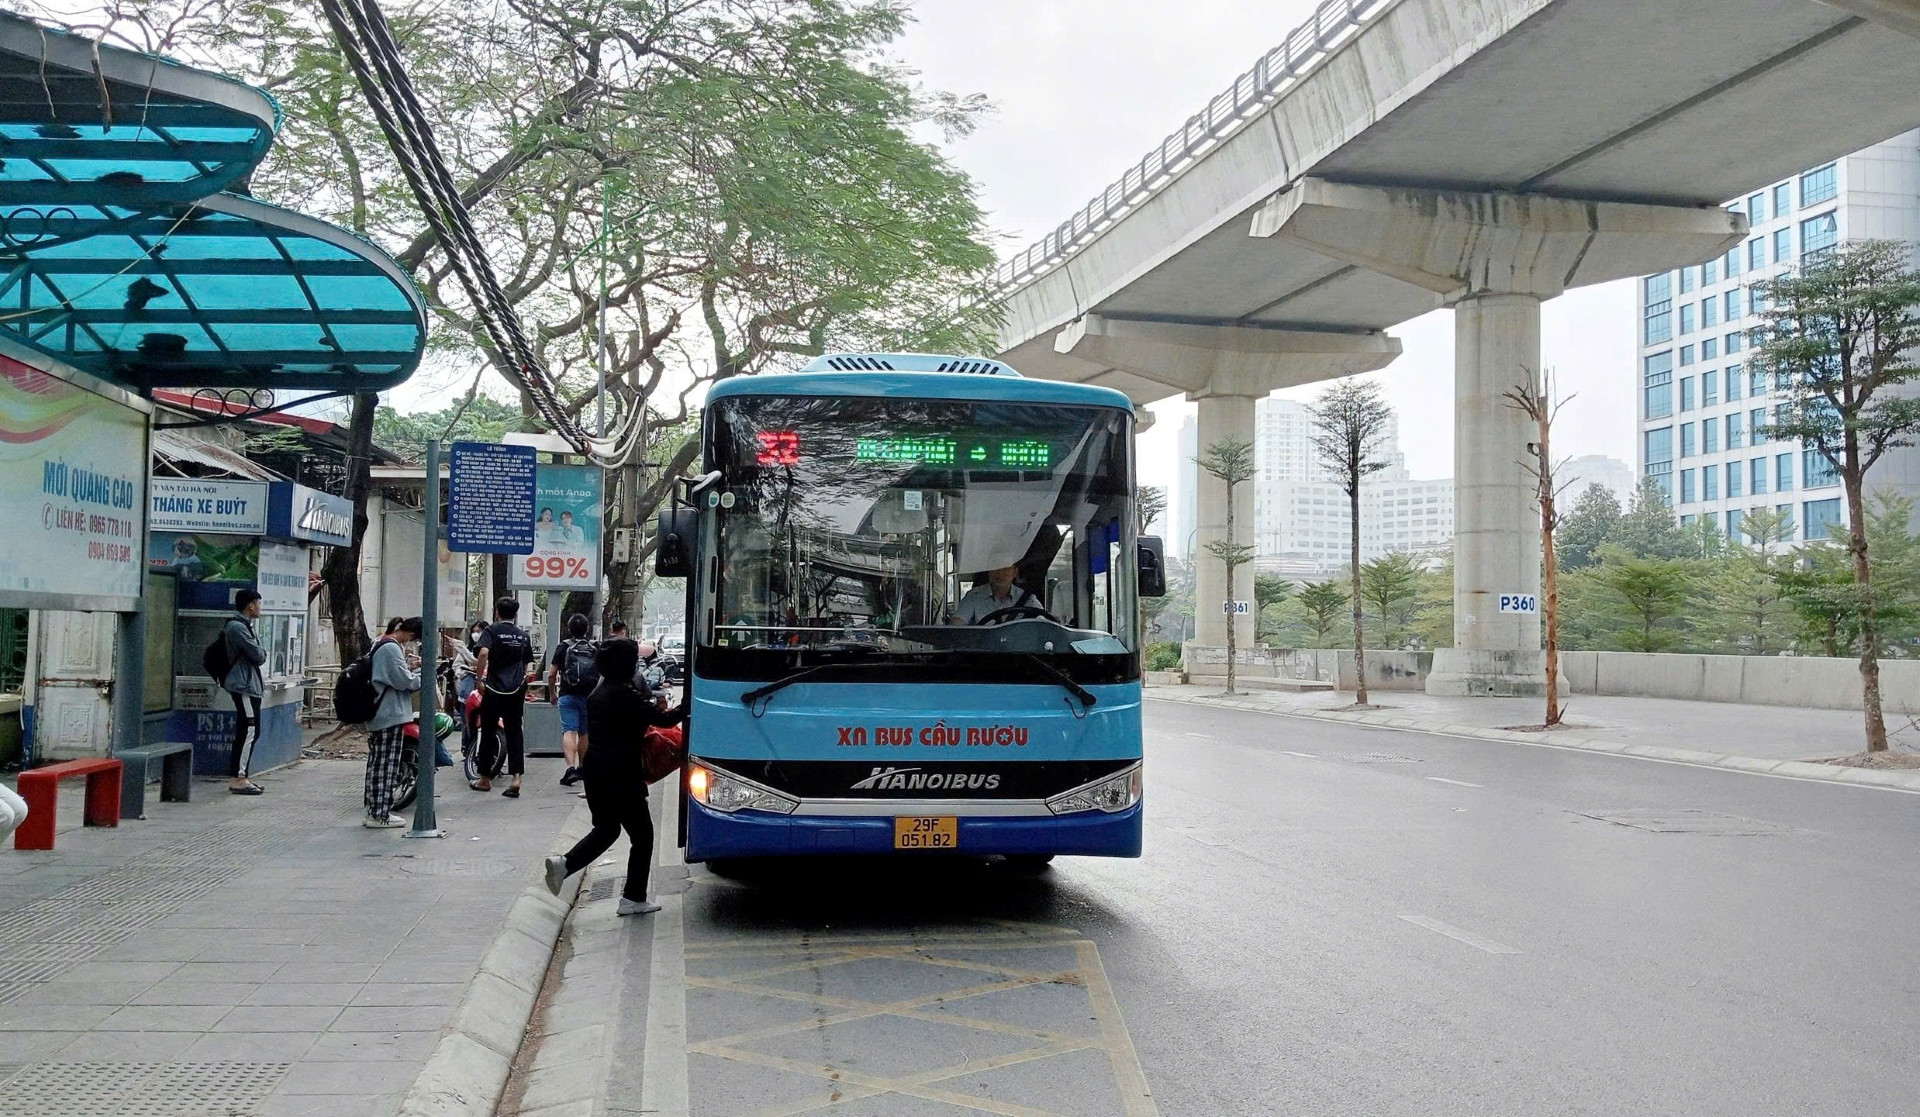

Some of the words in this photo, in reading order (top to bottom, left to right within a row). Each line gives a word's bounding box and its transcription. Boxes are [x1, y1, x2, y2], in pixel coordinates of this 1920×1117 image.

[43, 456, 68, 497] MỜI
[71, 462, 110, 505] QUẢNG
[112, 475, 133, 510] CÁO
[153, 494, 193, 513] THÁNG
[197, 498, 213, 514] XE
[216, 497, 247, 516] BUÝT
[56, 505, 74, 530] LIÊN
[89, 514, 106, 534] 0965
[107, 517, 119, 537] 778
[526, 557, 589, 579] 99%
[1500, 595, 1535, 612] P360
[875, 727, 914, 747] BUS
[919, 718, 961, 747] CẦU
[967, 724, 1030, 747] BƯƠU
[850, 767, 1001, 791] HANOIBUS
[913, 818, 940, 832] 29F
[902, 833, 951, 847] 051.82
